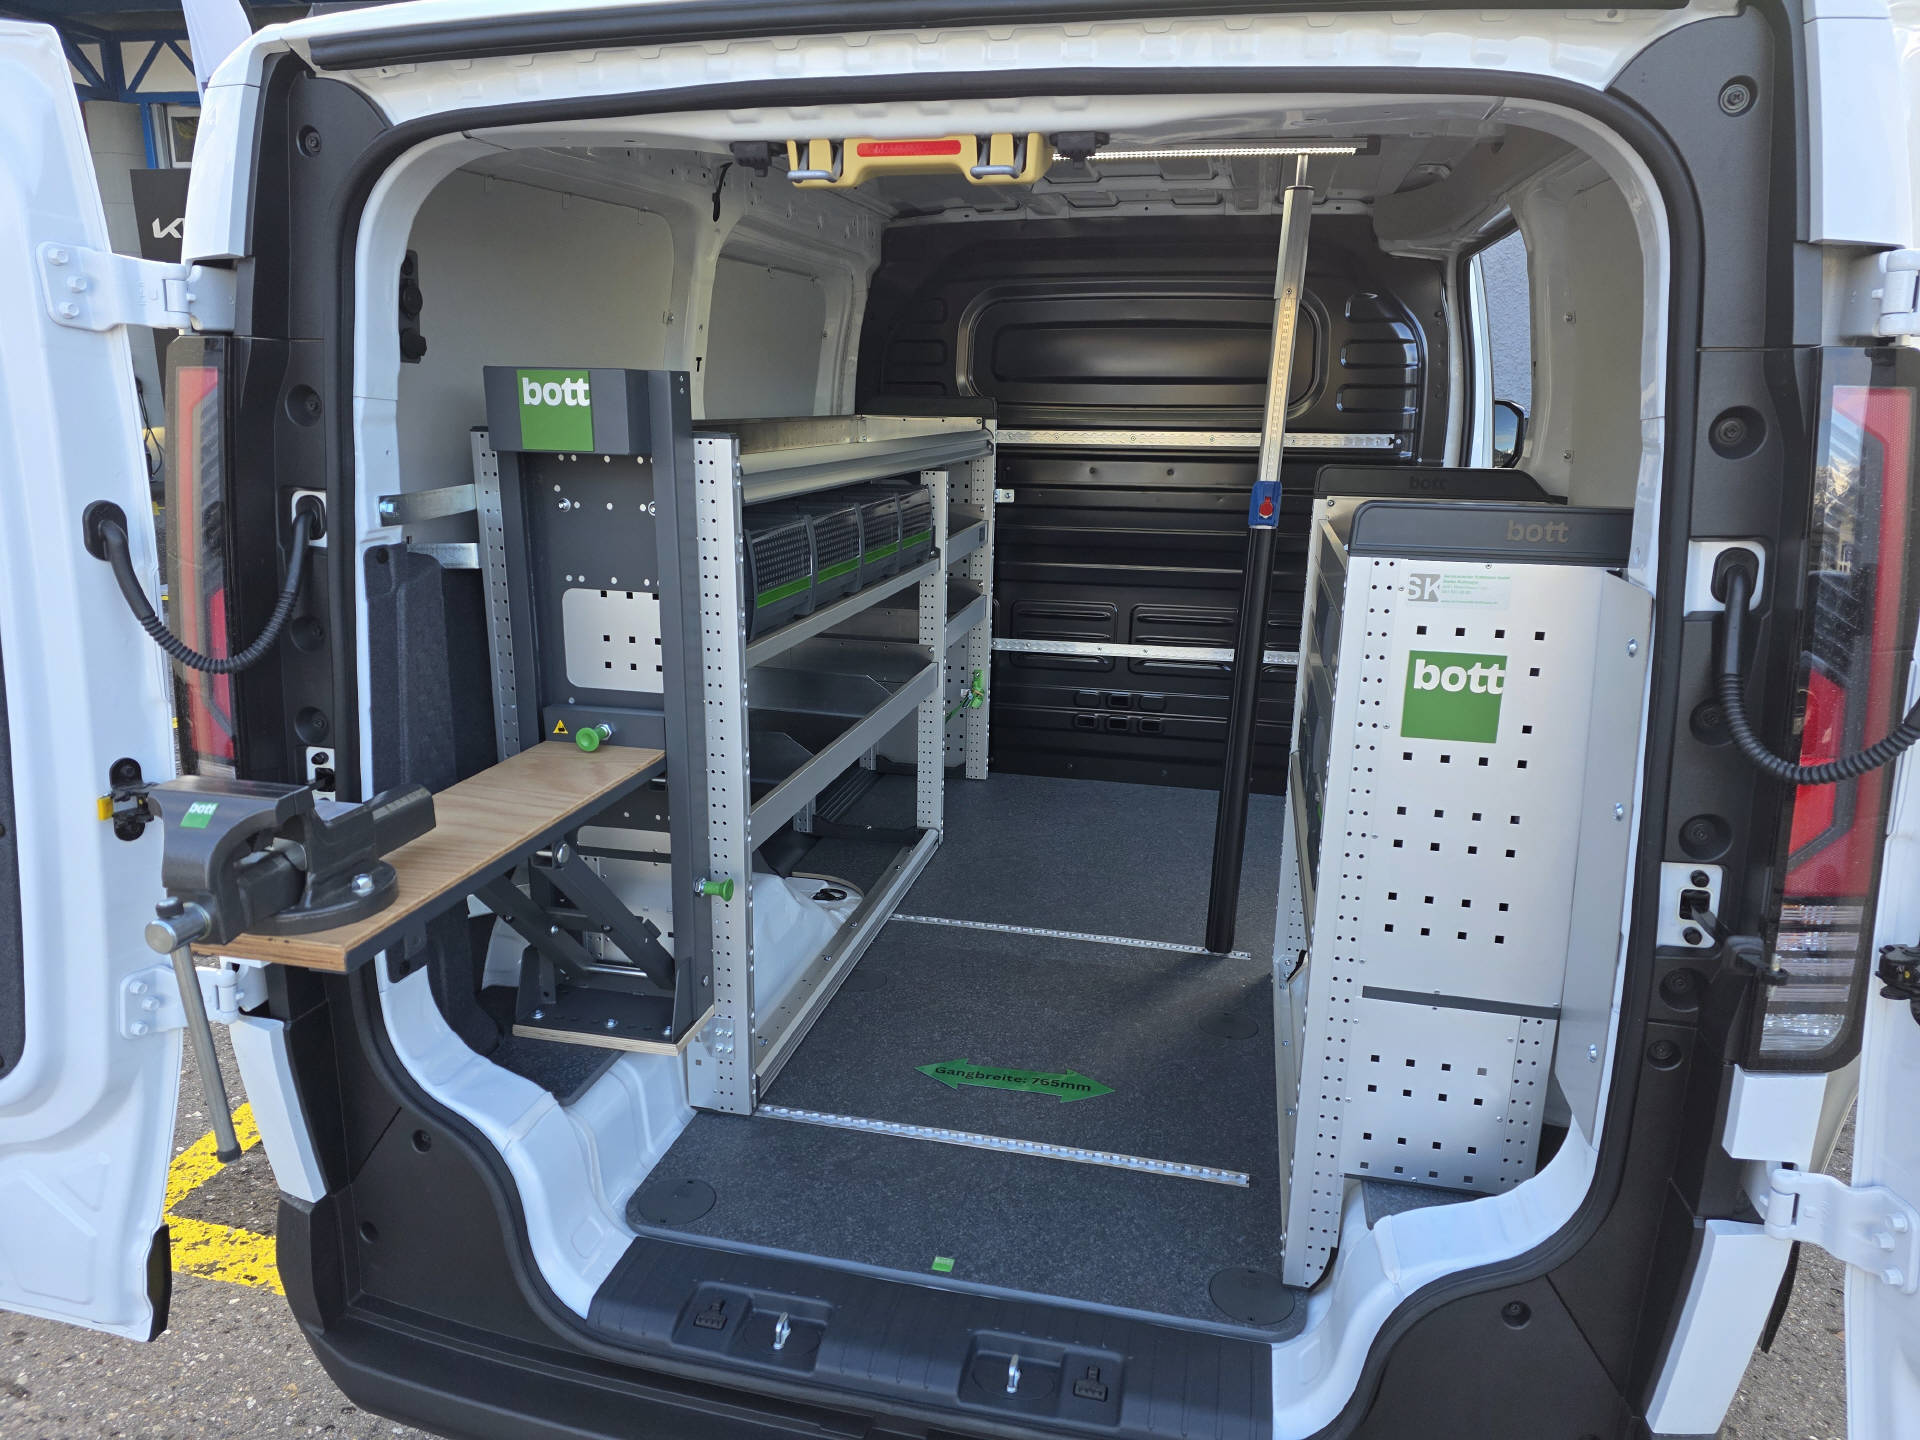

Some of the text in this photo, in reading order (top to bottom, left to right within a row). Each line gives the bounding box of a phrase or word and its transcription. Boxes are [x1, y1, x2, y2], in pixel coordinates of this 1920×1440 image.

[522, 377, 590, 407] bott
[1506, 519, 1569, 543] bott
[1408, 576, 1440, 601] SK
[1413, 658, 1506, 695] bott
[934, 1066, 1092, 1092] Gangbreite: 765mm
